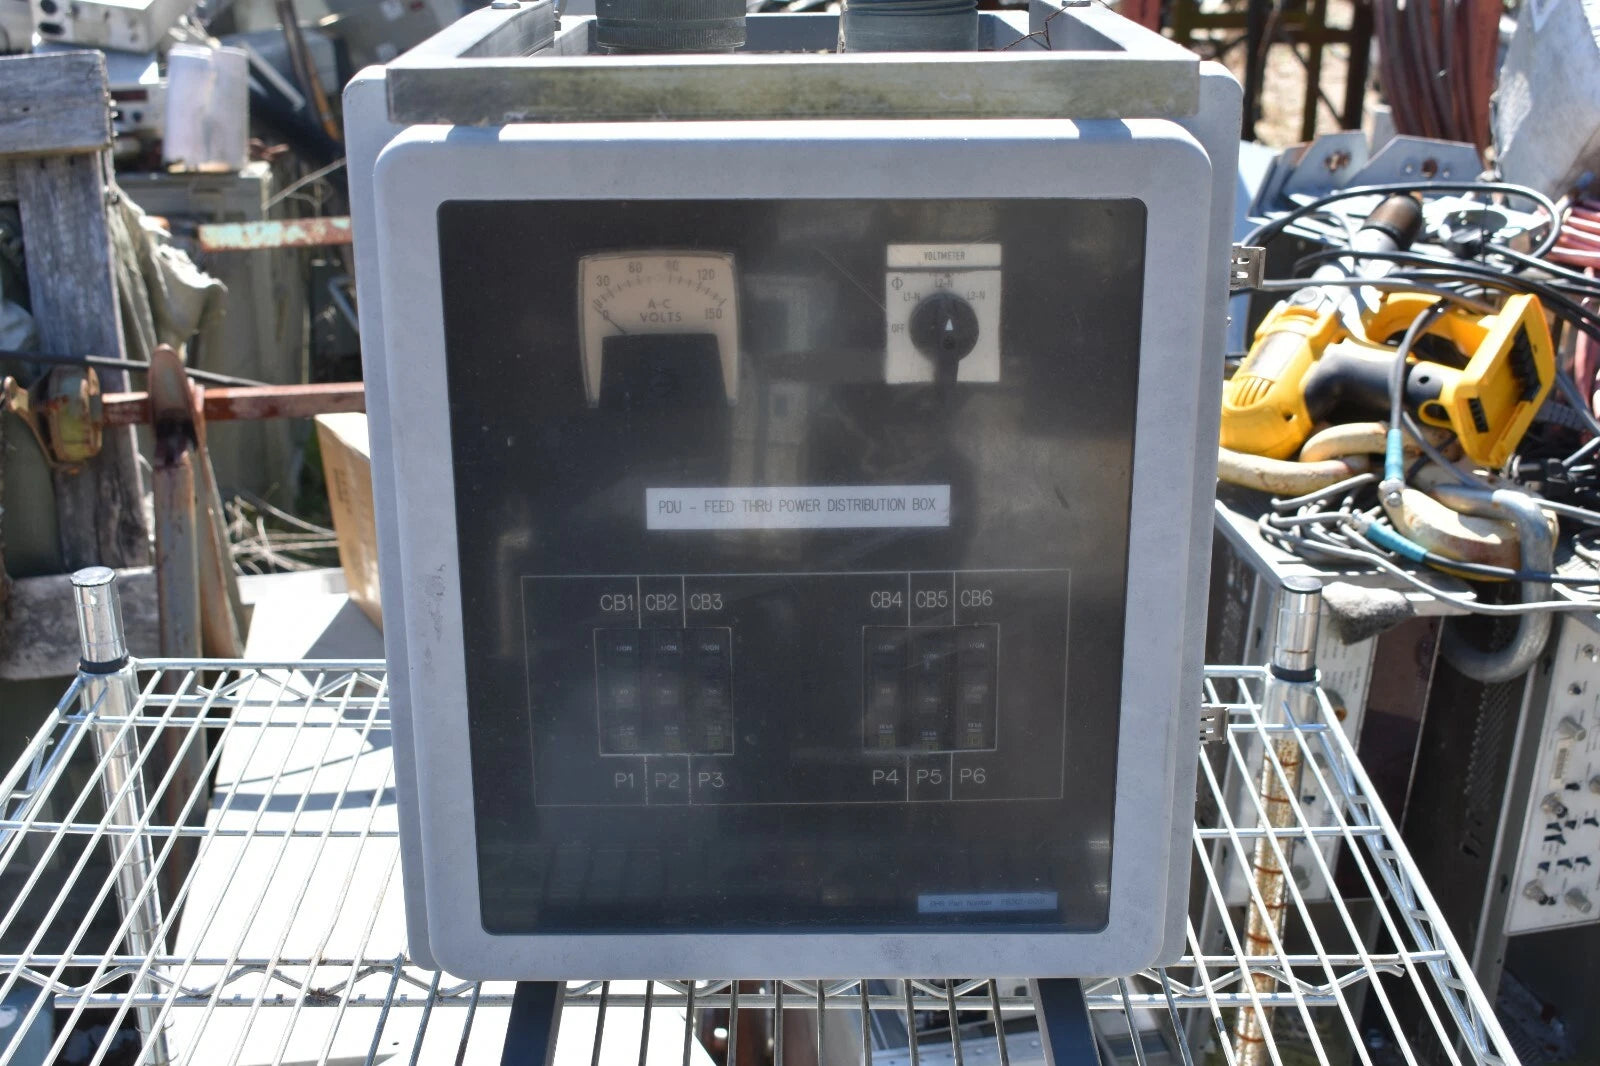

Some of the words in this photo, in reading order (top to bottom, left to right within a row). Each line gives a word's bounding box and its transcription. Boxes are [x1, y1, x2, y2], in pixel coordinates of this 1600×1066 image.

[924, 251, 965, 261] VOLTMETER
[596, 274, 610, 288] 30
[696, 268, 716, 281] 120
[639, 311, 682, 323] VOLTS
[704, 307, 722, 320] 150
[658, 500, 682, 514] PDU
[704, 499, 734, 513] FEED
[743, 499, 773, 513] THRU
[779, 498, 821, 513] POWER
[827, 497, 906, 512] DISTRIBUTION
[912, 497, 936, 511] BOX
[600, 594, 634, 611] CB1
[645, 594, 678, 611] CB2
[690, 593, 724, 611] CB3
[870, 591, 903, 609] CB4
[915, 590, 948, 608] CB5
[960, 589, 993, 607] CB6
[615, 772, 635, 789] P1
[655, 772, 680, 788] P2
[698, 772, 725, 788] P3
[872, 769, 900, 786] P4
[916, 769, 943, 785] P5
[960, 768, 986, 785] P6
